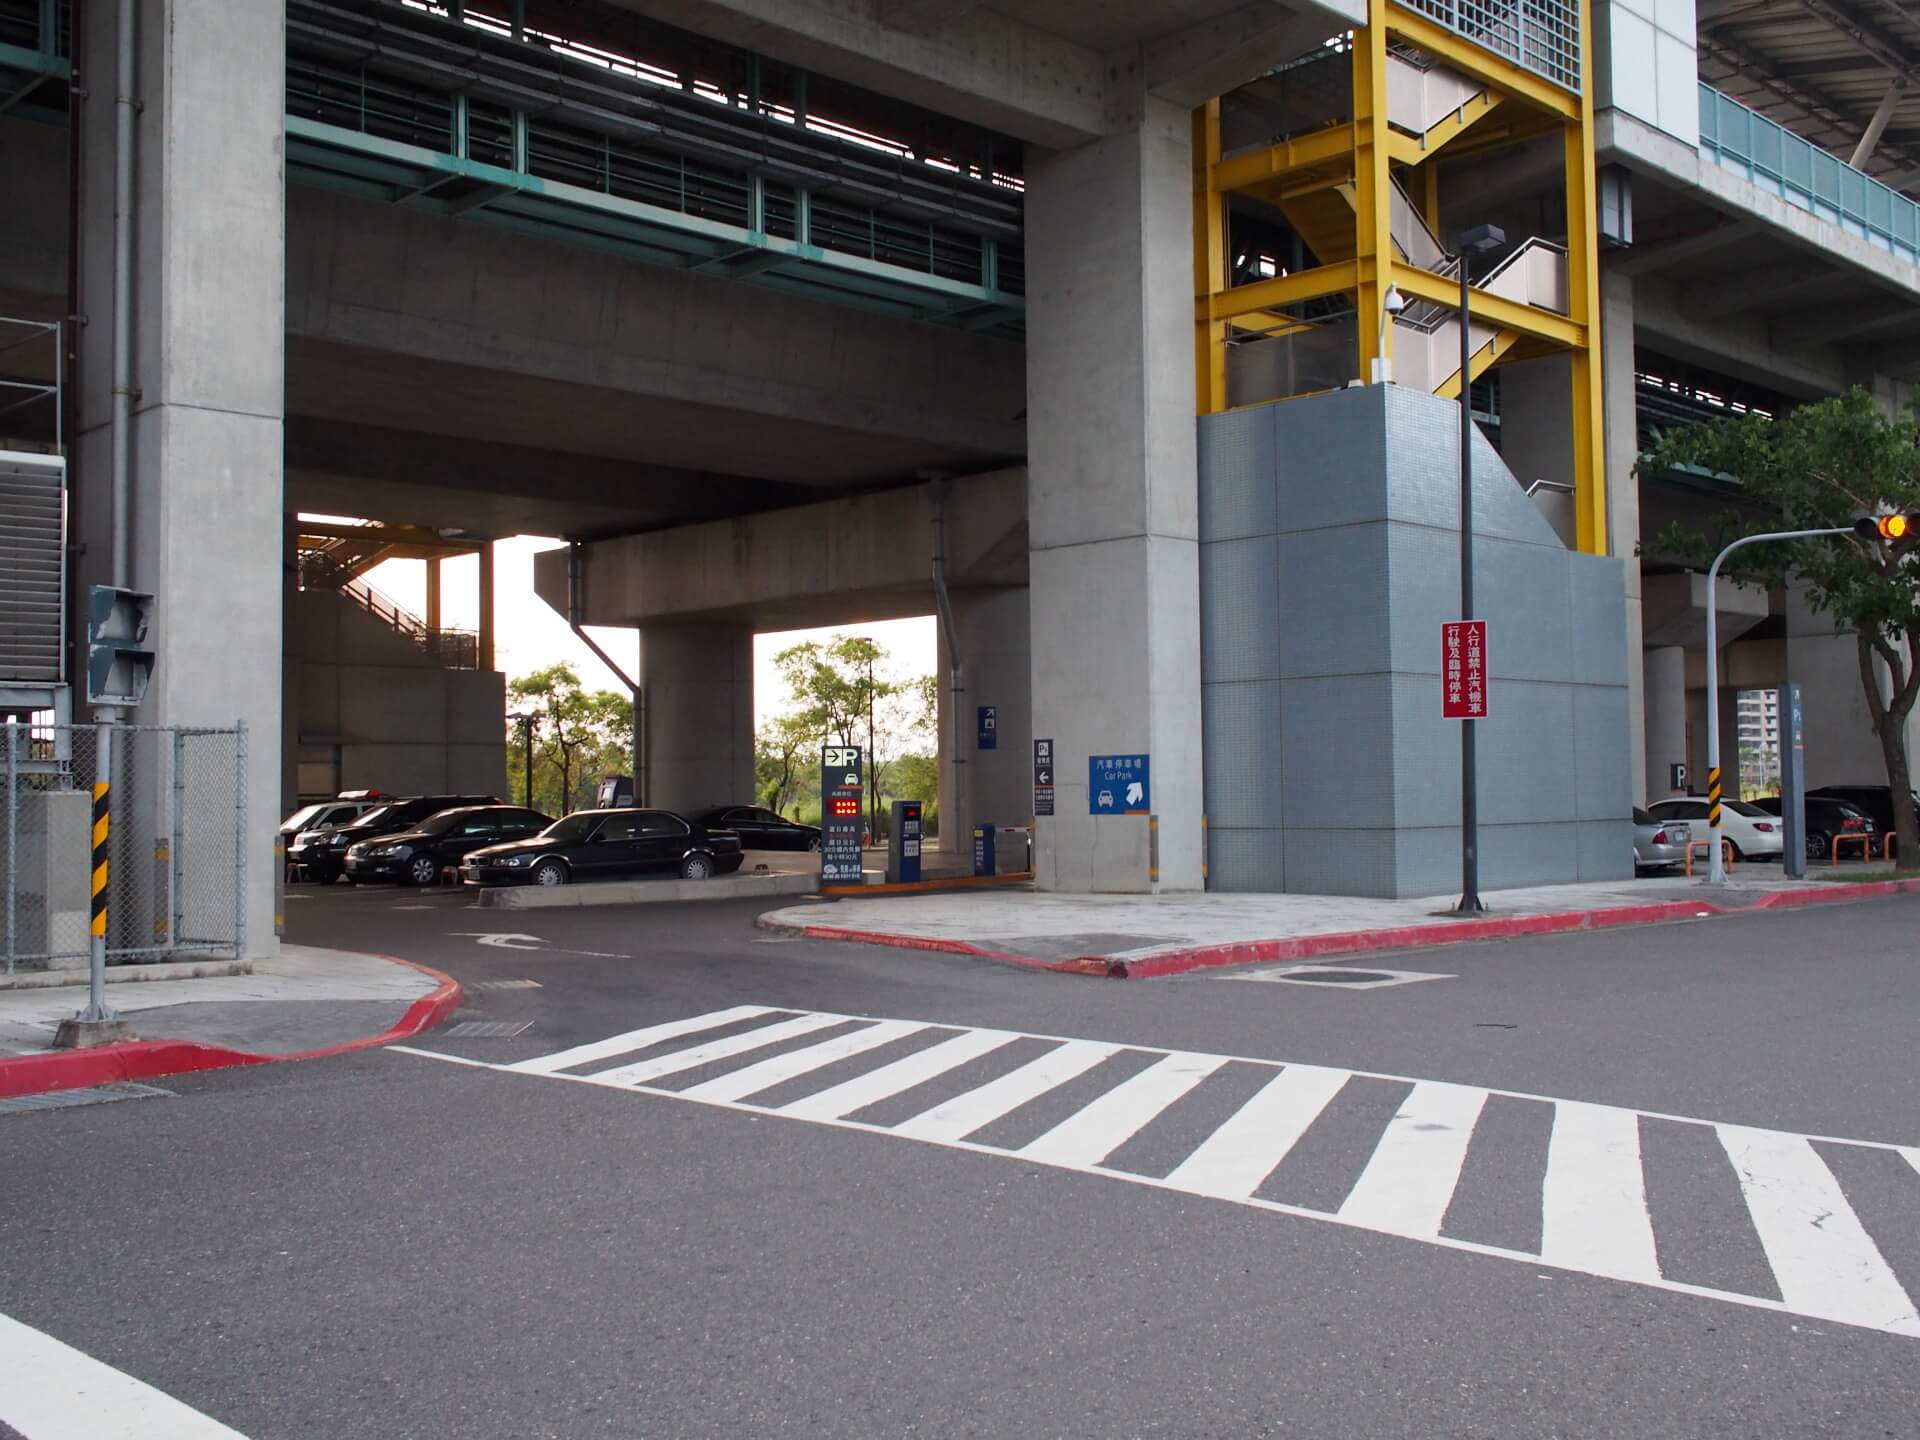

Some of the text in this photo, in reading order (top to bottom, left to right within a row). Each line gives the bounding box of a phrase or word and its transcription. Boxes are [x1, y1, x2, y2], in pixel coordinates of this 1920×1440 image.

[1448, 625, 1461, 704] 行駛及臨時停車
[1468, 624, 1482, 714] 人行道禁止汽機車
[1096, 758, 1142, 769] 汽車停車場
[1104, 770, 1132, 780] Car Park
